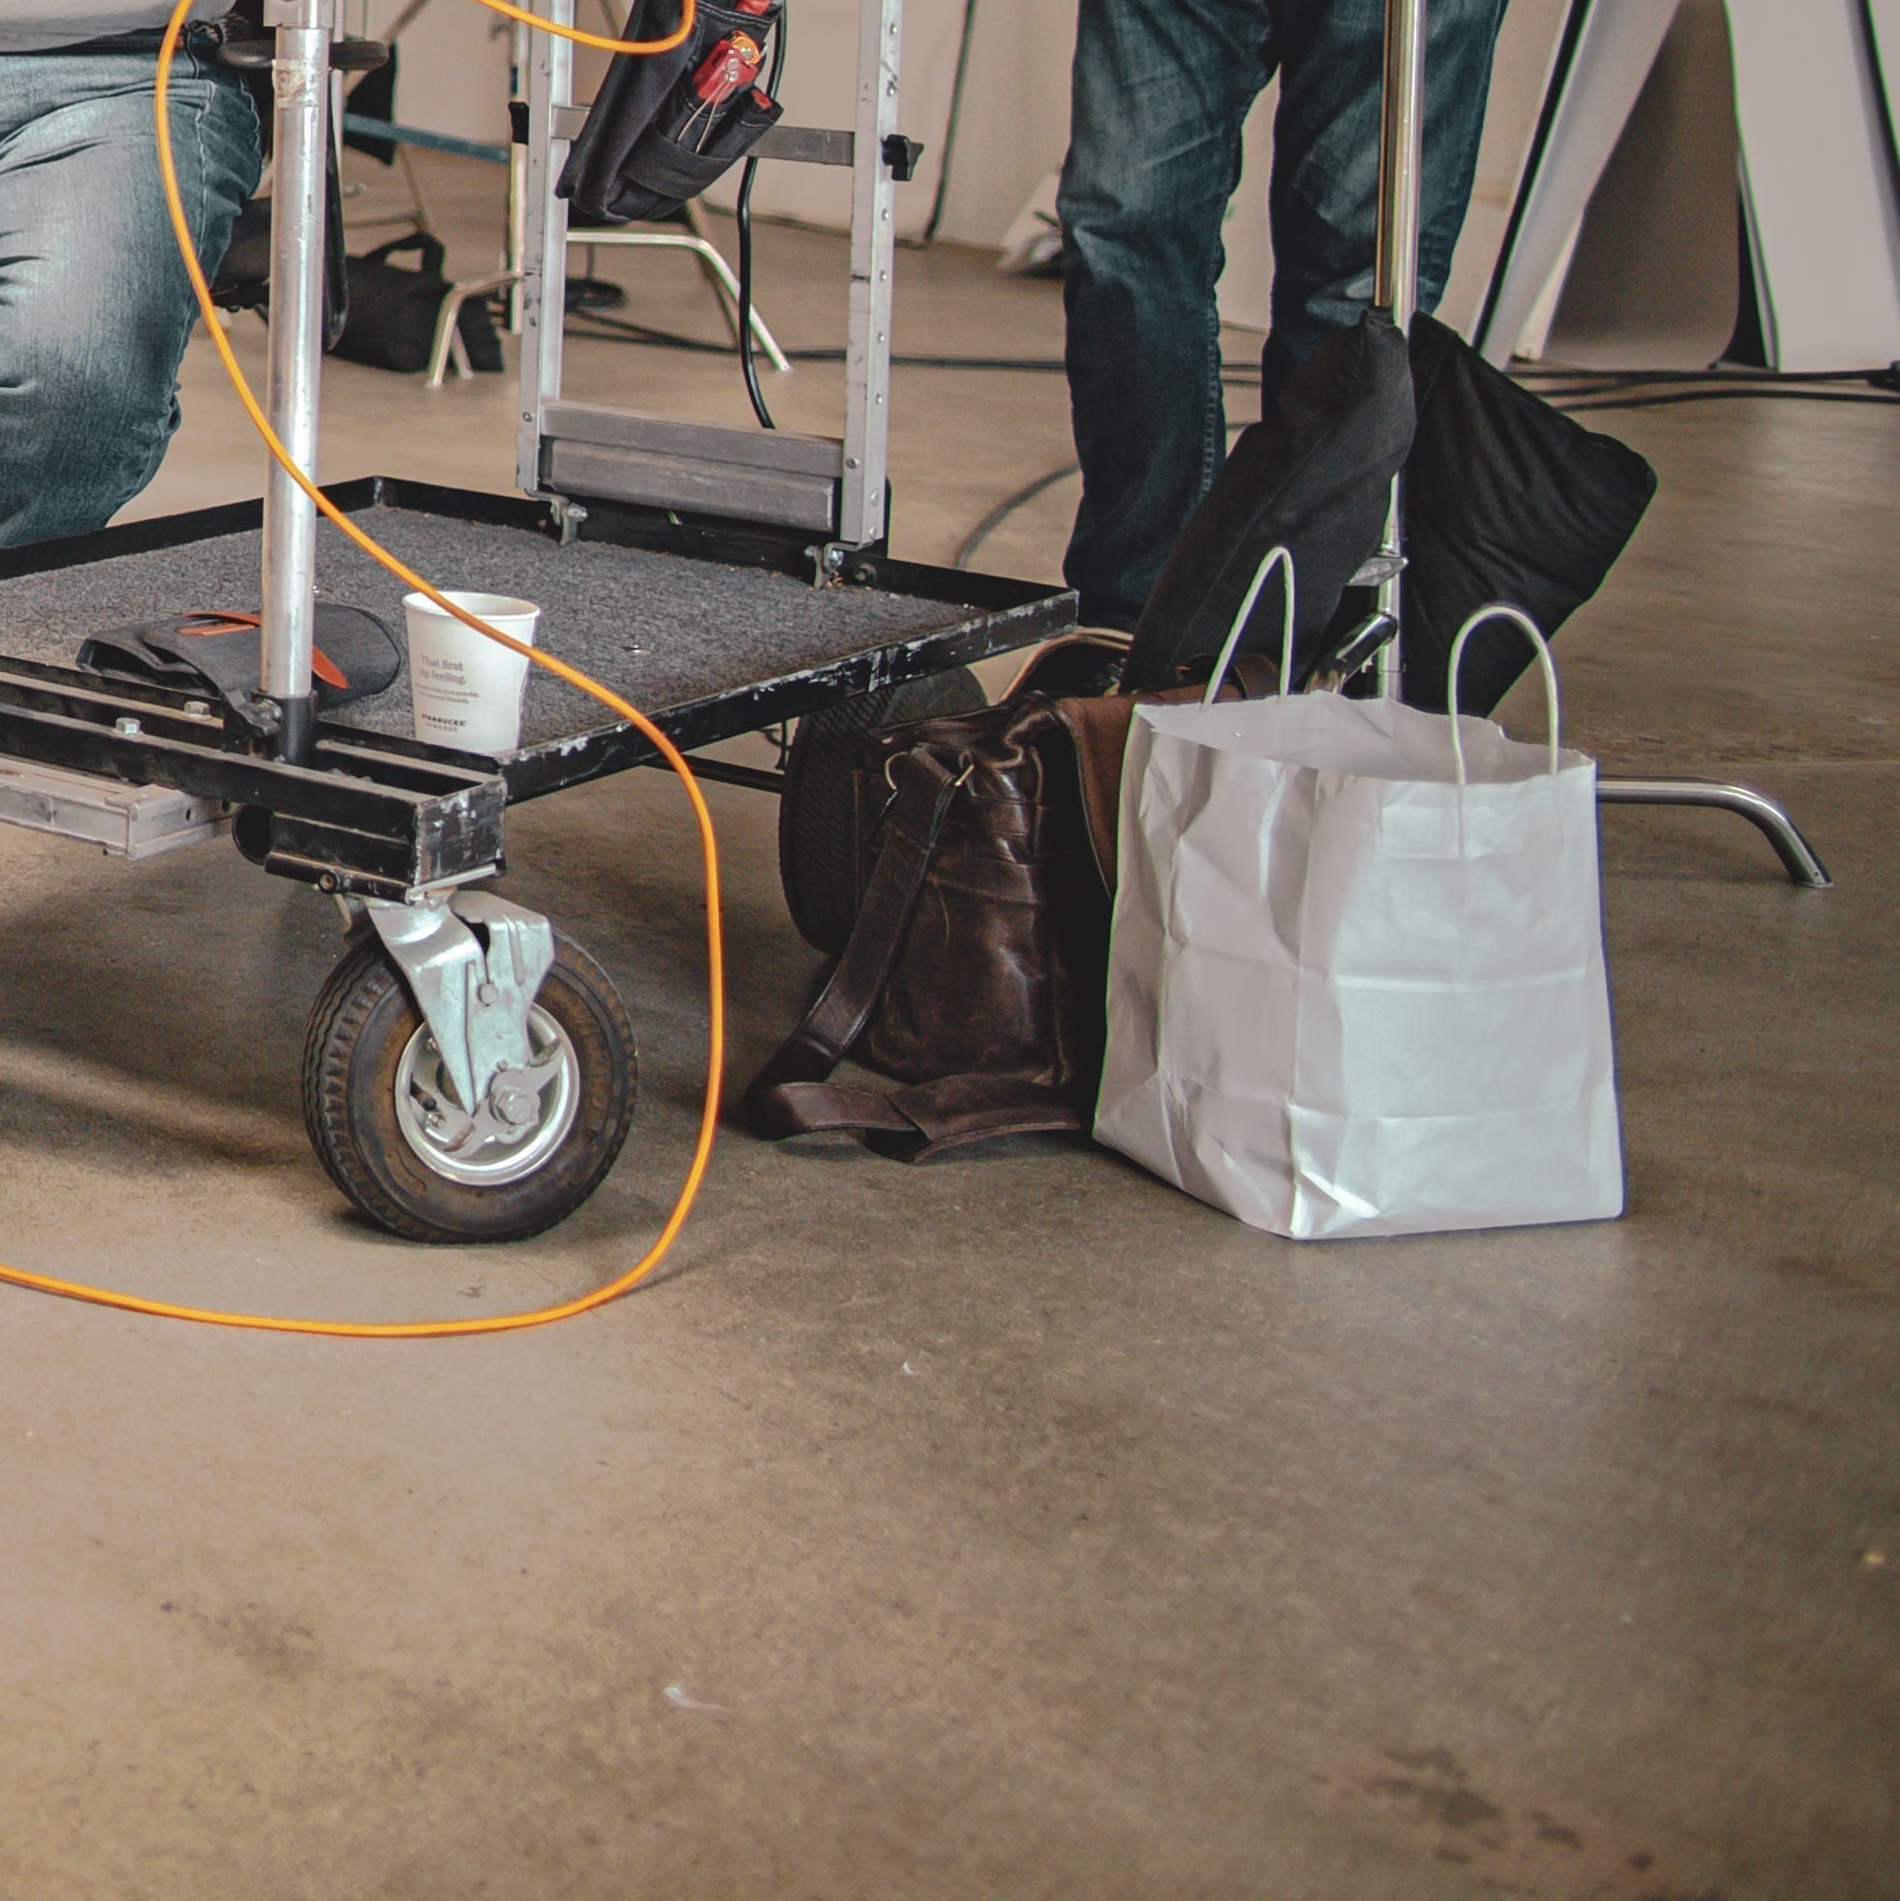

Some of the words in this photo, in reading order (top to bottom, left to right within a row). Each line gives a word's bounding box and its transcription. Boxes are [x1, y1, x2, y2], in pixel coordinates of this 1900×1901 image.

[421, 654, 440, 669] That
[442, 659, 463, 671] first
[421, 712, 465, 726] STARBUCKS
